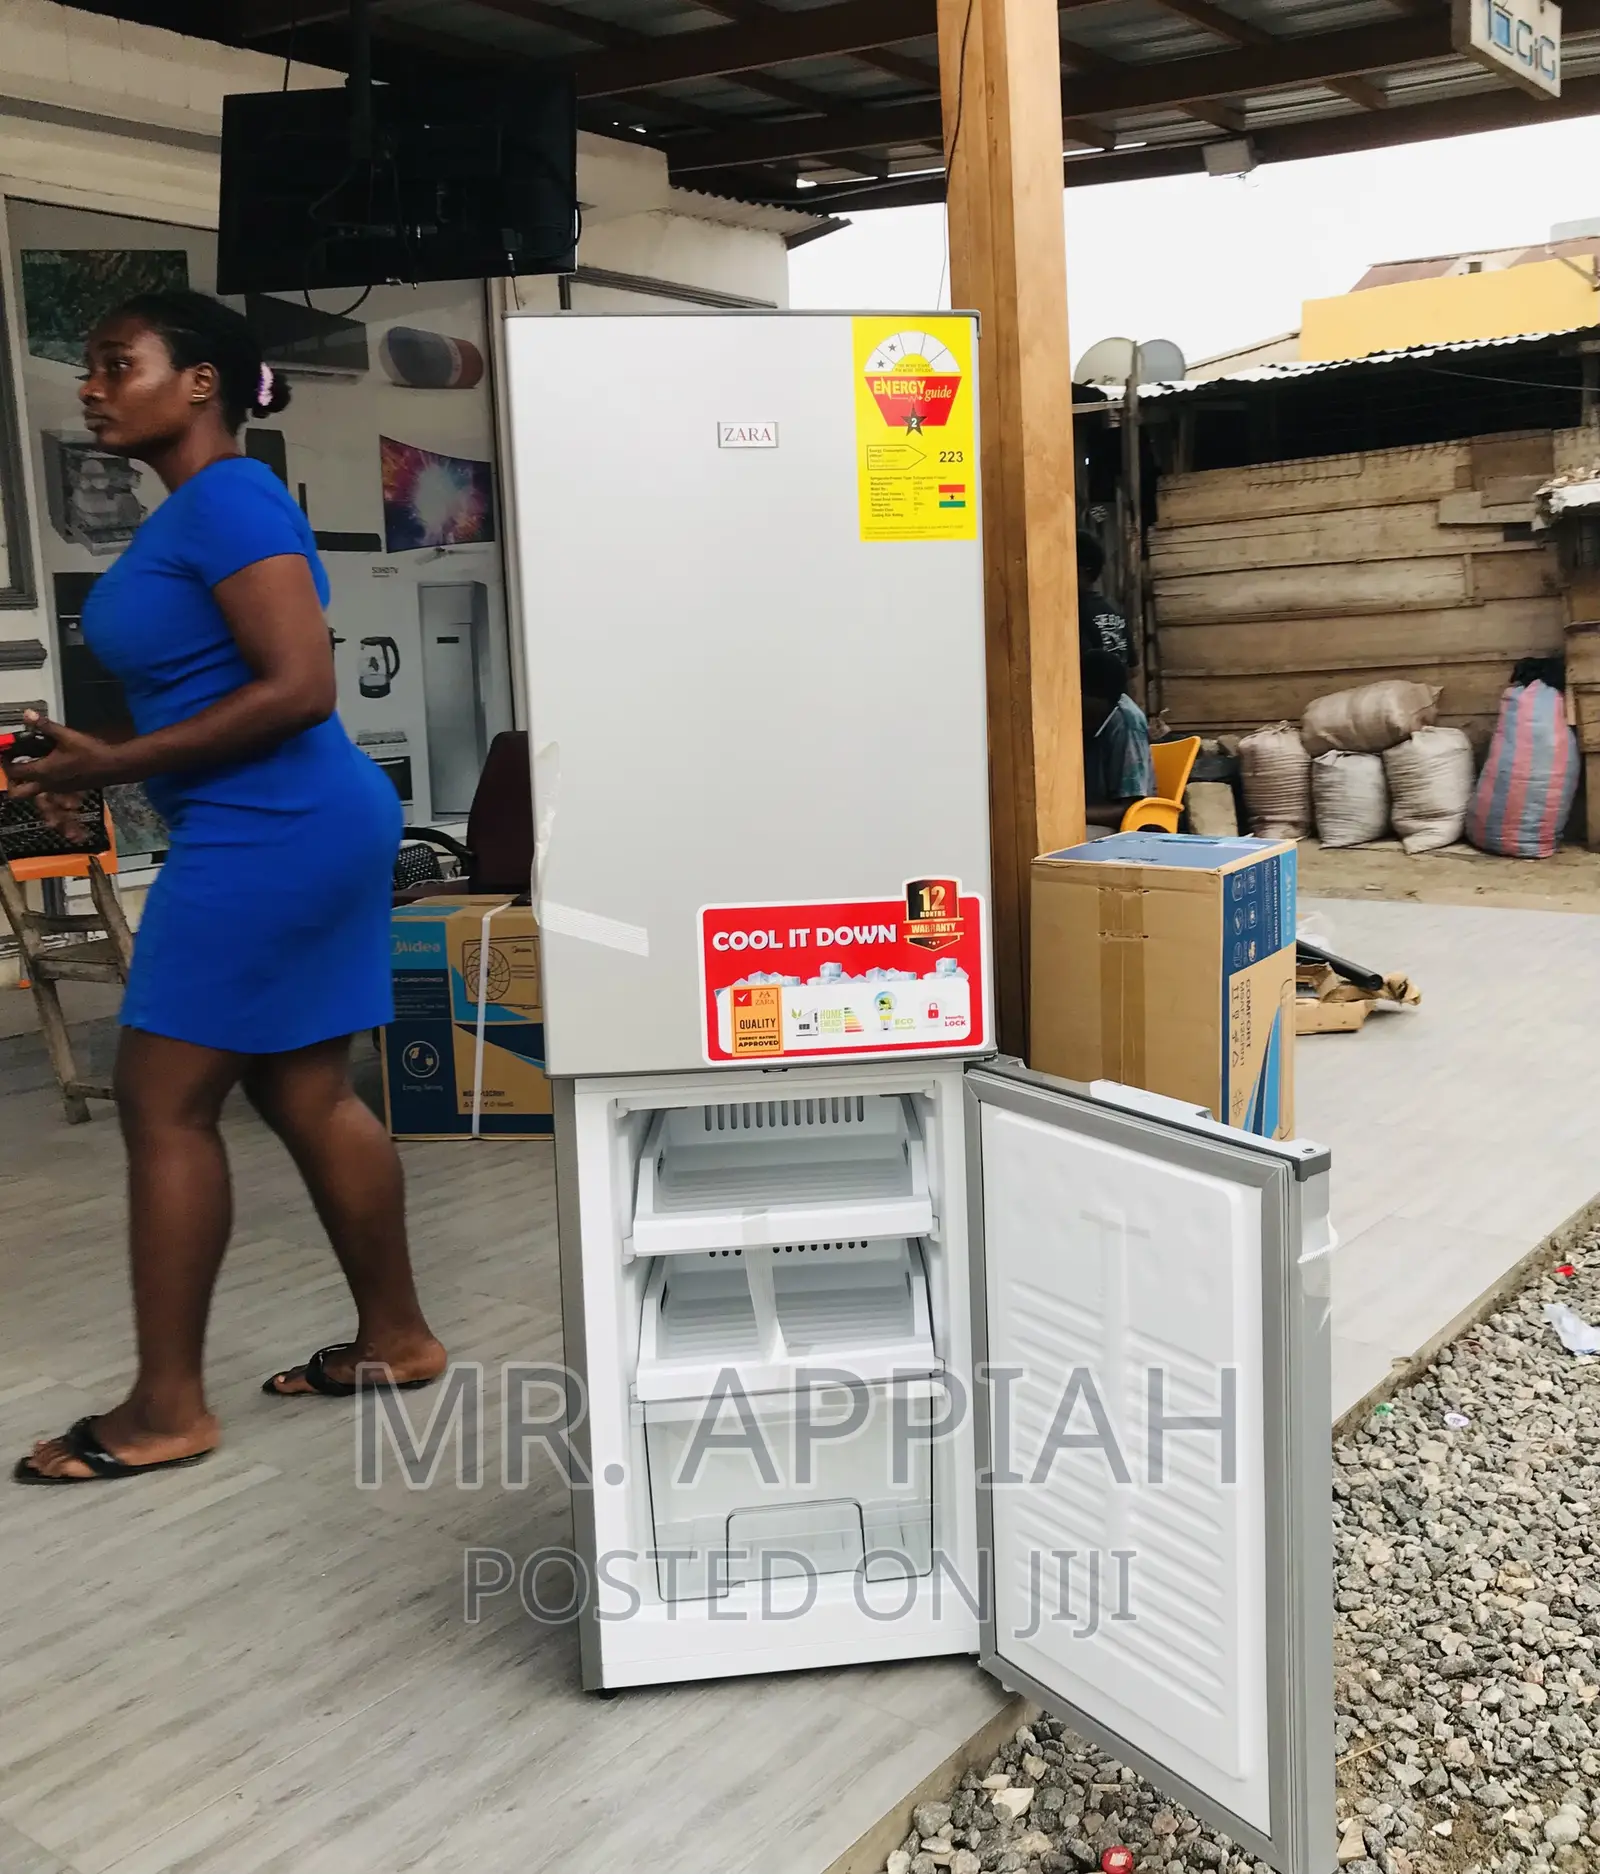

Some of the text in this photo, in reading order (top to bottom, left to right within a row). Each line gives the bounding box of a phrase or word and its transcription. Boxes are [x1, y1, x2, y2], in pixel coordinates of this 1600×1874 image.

[873, 377, 952, 402] ENERGY guide
[910, 417, 918, 428] 2
[723, 427, 773, 442] ZARA
[939, 450, 964, 463] 223
[919, 885, 946, 911] 12
[919, 910, 947, 918] MONTHS
[911, 922, 956, 934] WARRANTY
[712, 924, 898, 952] COOL IT DOWN
[739, 1017, 777, 1030] QUALITY
[894, 1017, 914, 1026] ECO
[944, 1019, 967, 1027] LOCK
[738, 1039, 780, 1048] APPROVED
